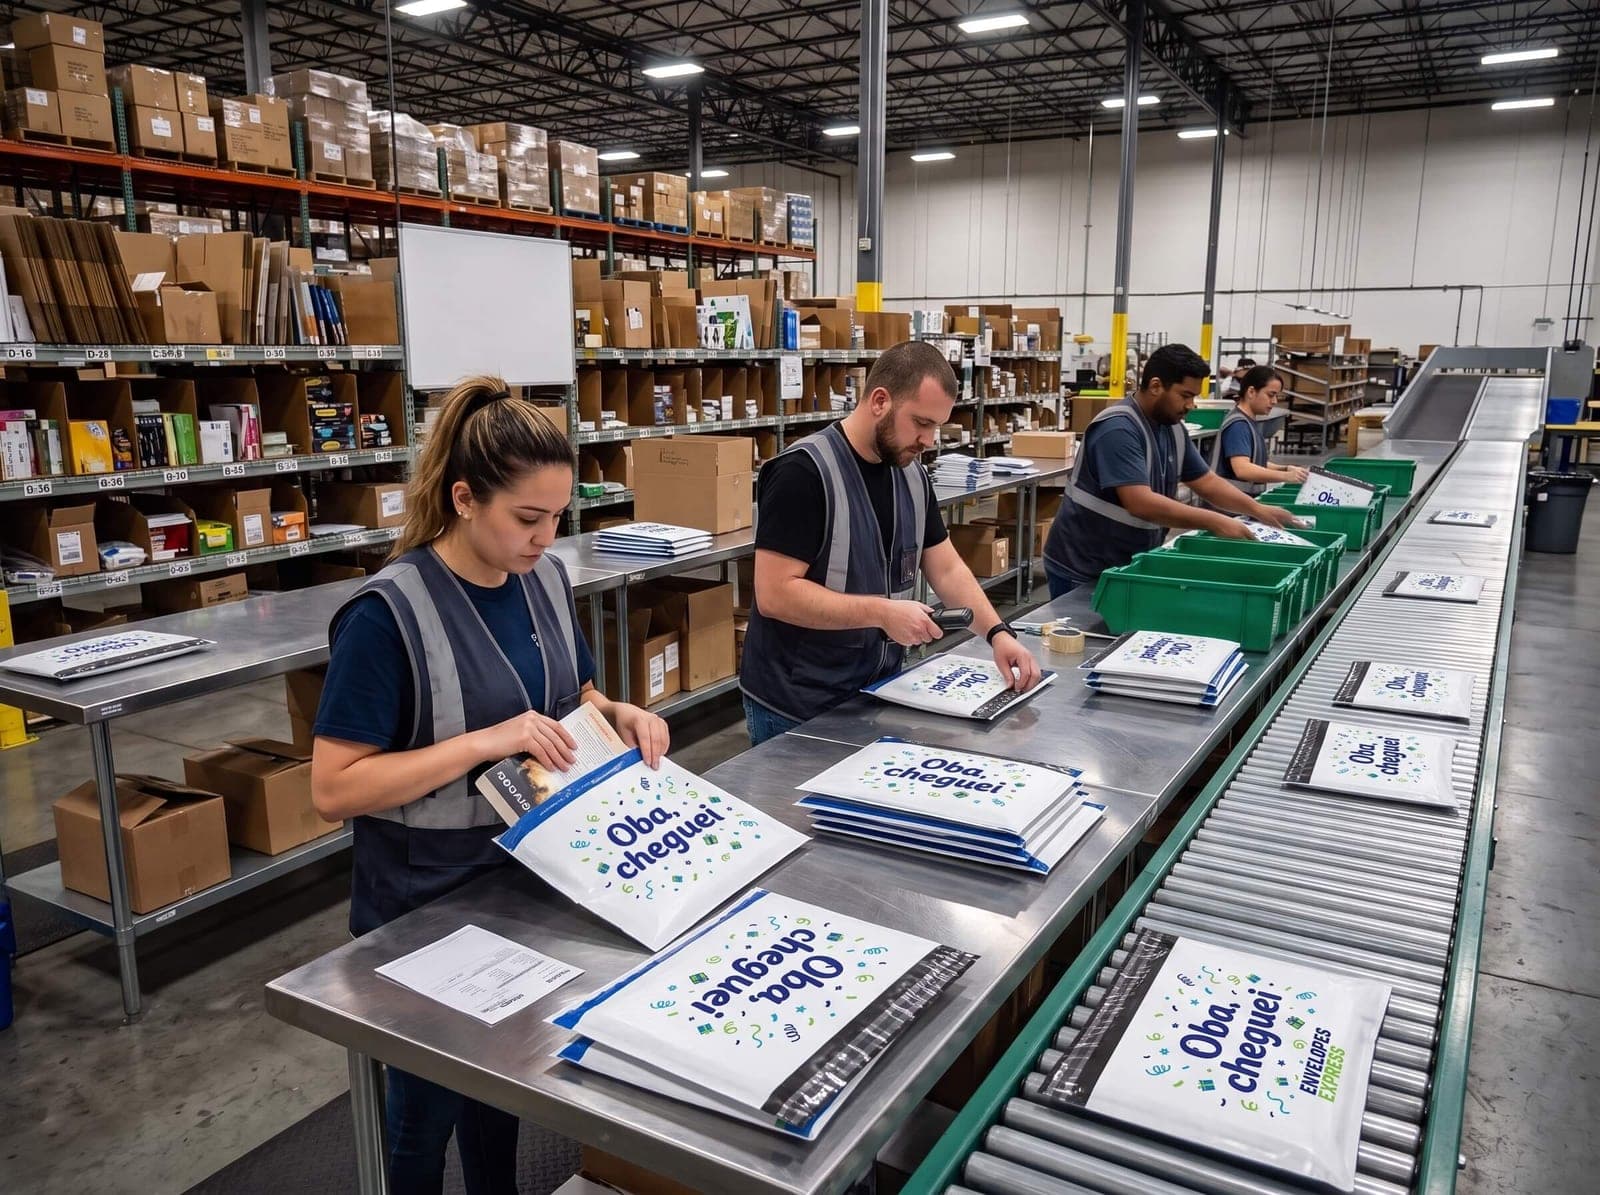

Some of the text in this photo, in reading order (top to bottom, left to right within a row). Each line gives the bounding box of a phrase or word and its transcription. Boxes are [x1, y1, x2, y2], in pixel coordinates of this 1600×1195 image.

[8, 349, 33, 358] D-16
[921, 758, 986, 780] Oba,
[1349, 741, 1378, 764] Oba,
[1376, 735, 1407, 776] cheguei
[884, 767, 1006, 795] cheguei
[606, 806, 681, 847] Oba,
[616, 804, 725, 879] cheguei
[691, 928, 816, 1019] cheguei
[749, 955, 844, 1005] Oba,
[1179, 1002, 1241, 1059] Oba,
[1220, 988, 1283, 1093] cheguei
[1299, 1027, 1332, 1096] ENVELOPES
[1318, 1045, 1346, 1104] EXPRESS
